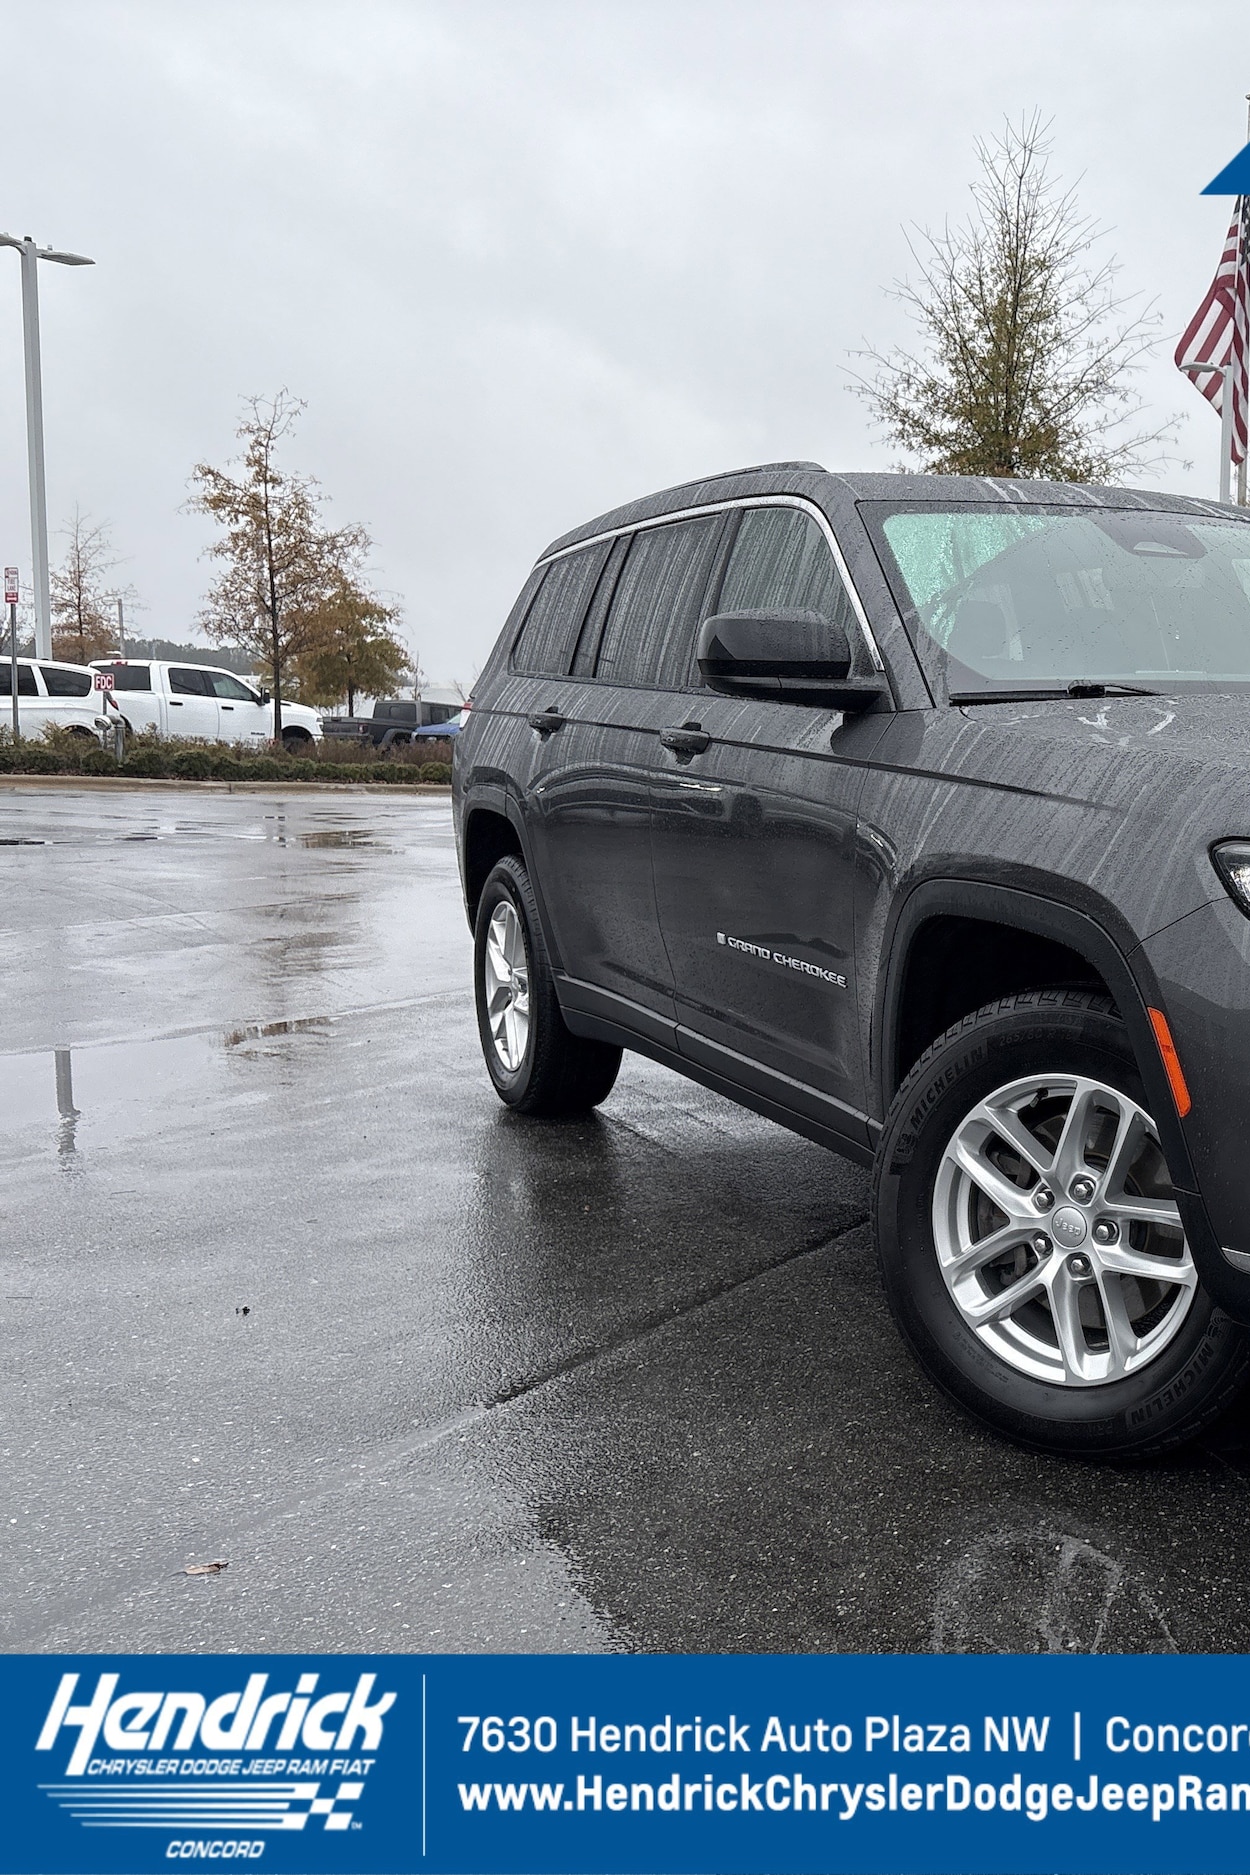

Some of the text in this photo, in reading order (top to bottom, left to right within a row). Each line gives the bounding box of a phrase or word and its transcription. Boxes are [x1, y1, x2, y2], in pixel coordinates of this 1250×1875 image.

[96, 675, 113, 690] FDC
[727, 936, 848, 988] GRAND CHEROKEE
[909, 1044, 985, 1132] MICHELIN
[1055, 1217, 1081, 1237] Jeep
[1130, 1341, 1215, 1427] MICHELIN
